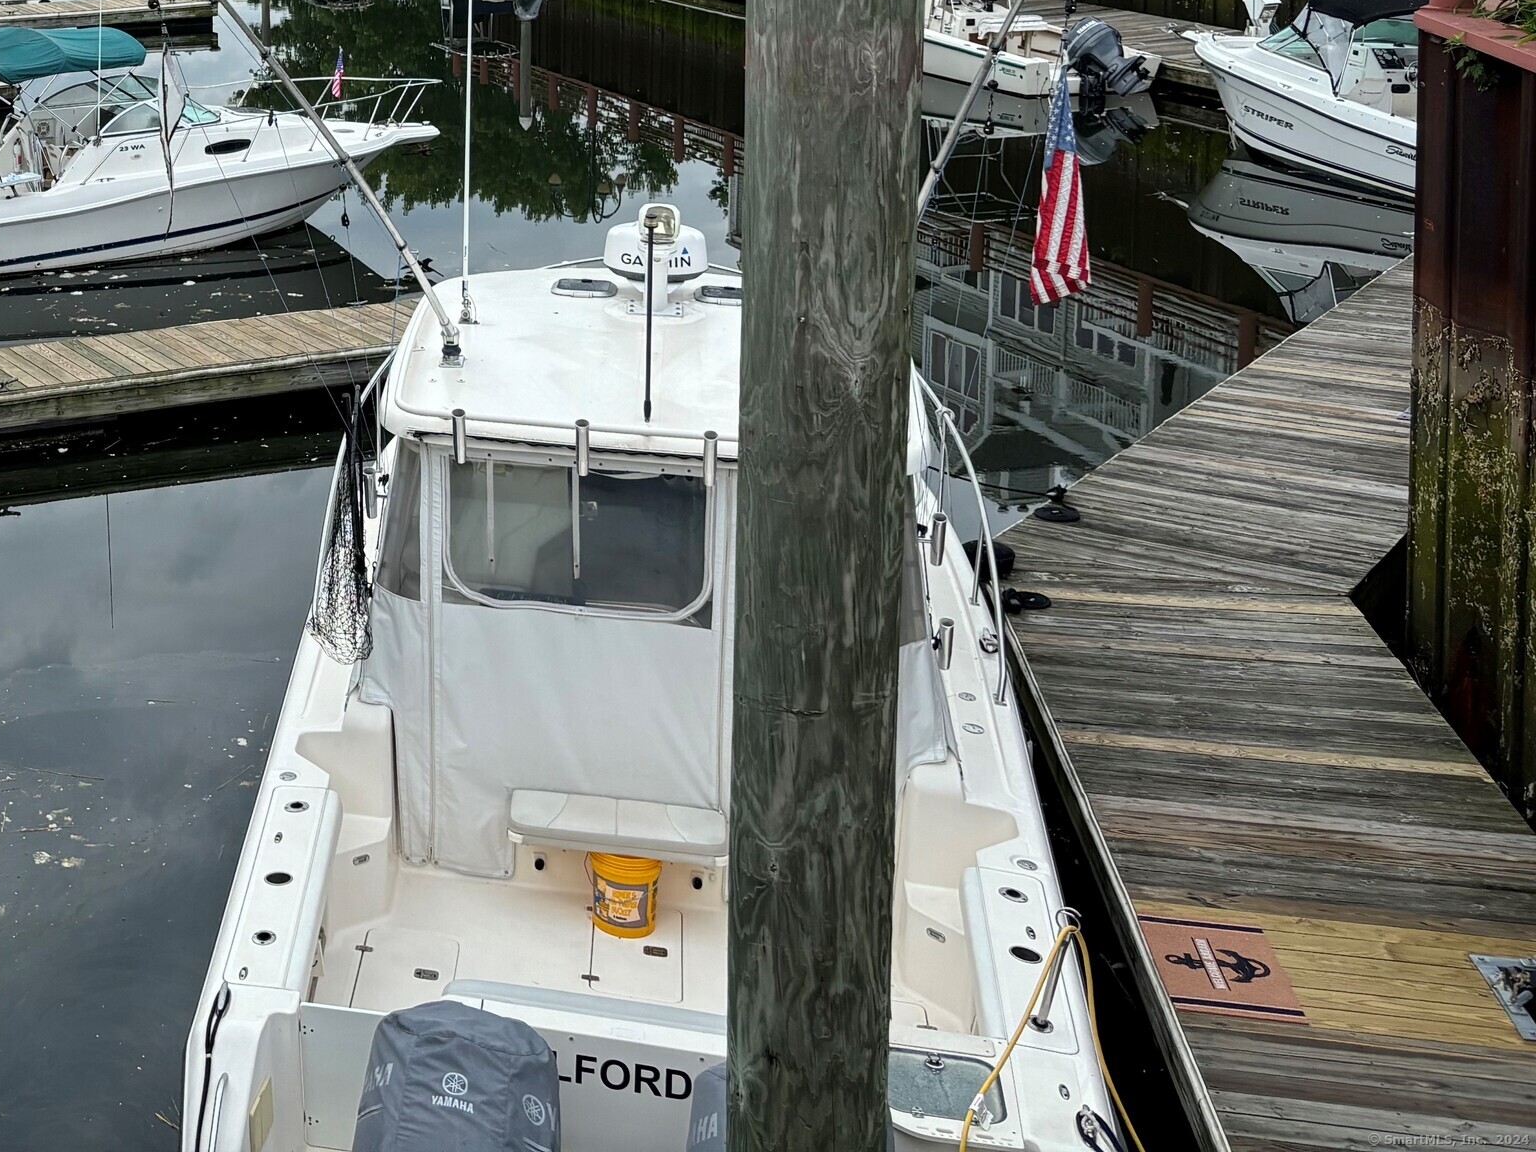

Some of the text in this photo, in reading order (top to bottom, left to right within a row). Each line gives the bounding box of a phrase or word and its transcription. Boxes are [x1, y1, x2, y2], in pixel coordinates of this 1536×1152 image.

[1243, 104, 1294, 131] STRIPER
[620, 252, 692, 268] GAIN
[431, 1095, 474, 1114] YAMAHA
